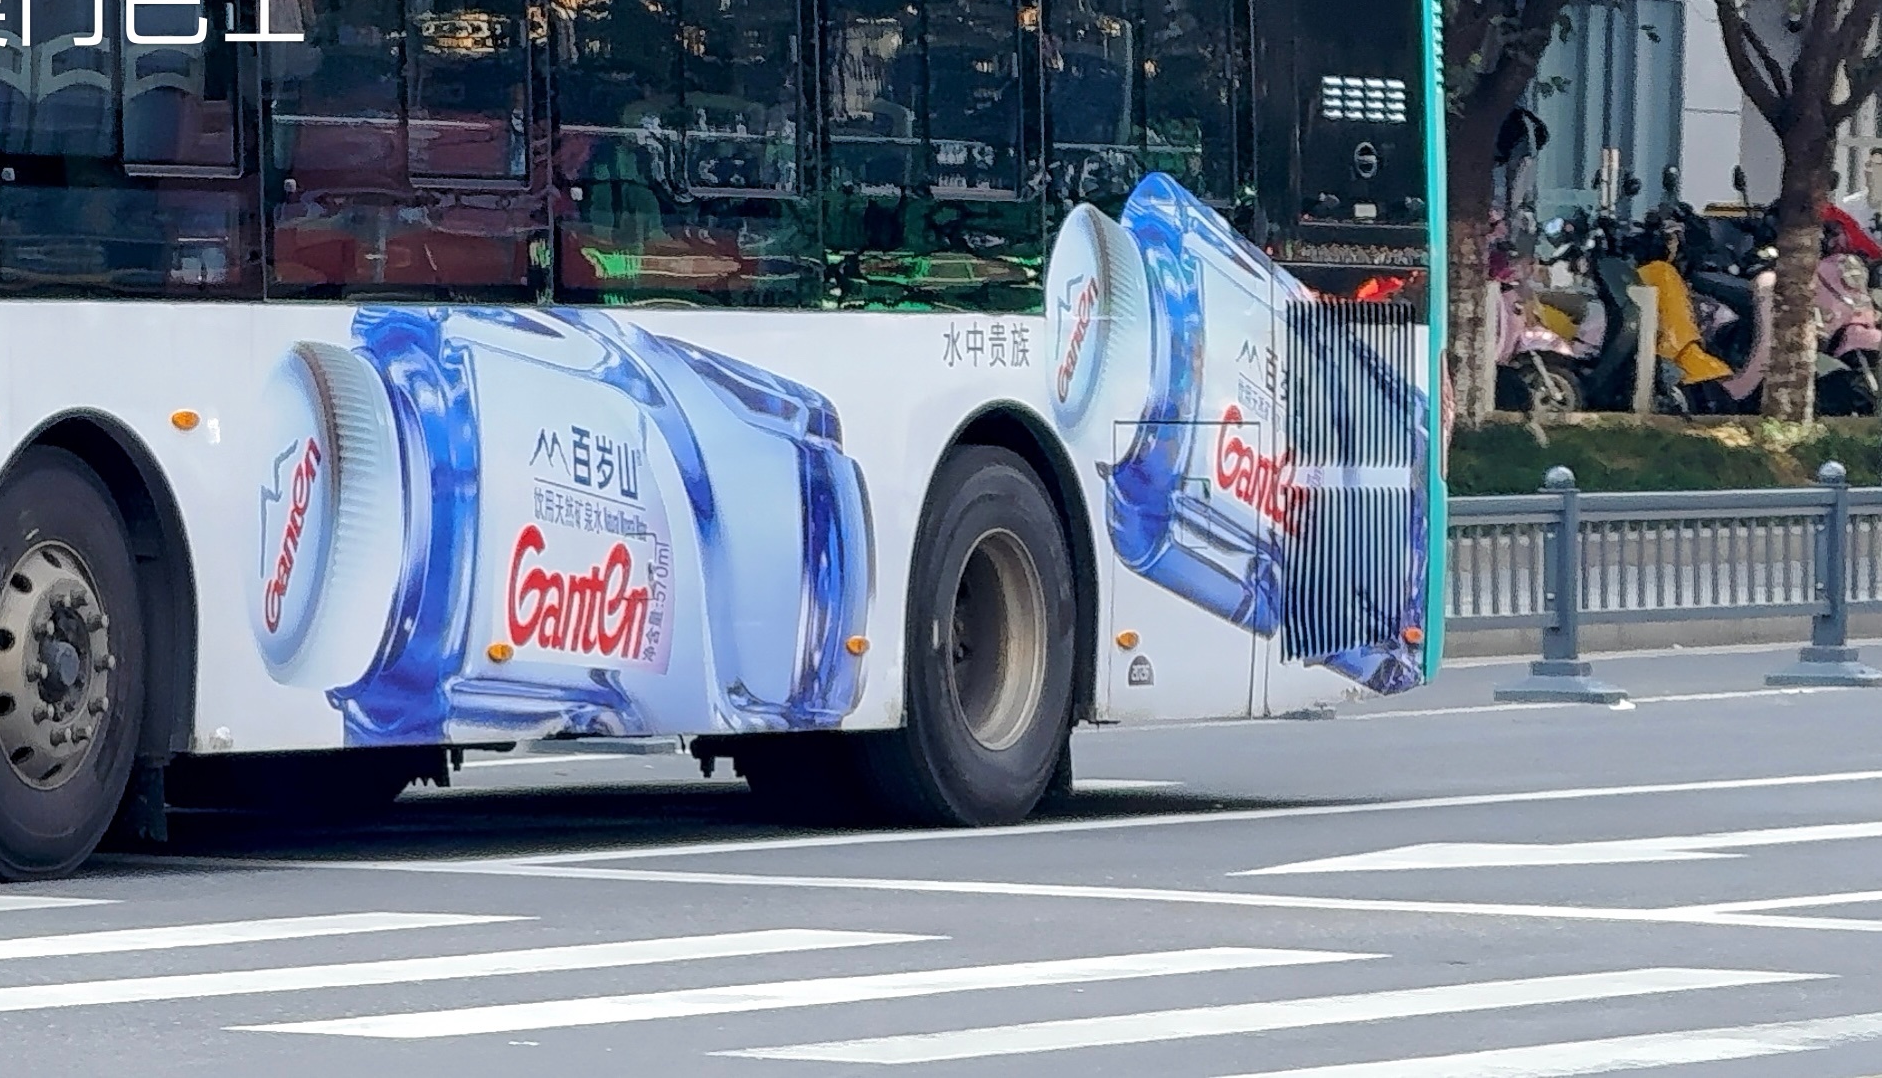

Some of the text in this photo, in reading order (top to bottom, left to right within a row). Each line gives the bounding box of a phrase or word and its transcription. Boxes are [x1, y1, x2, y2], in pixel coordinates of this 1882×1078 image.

[942, 321, 1031, 369] 水中贵族
[573, 425, 639, 500] 百岁山
